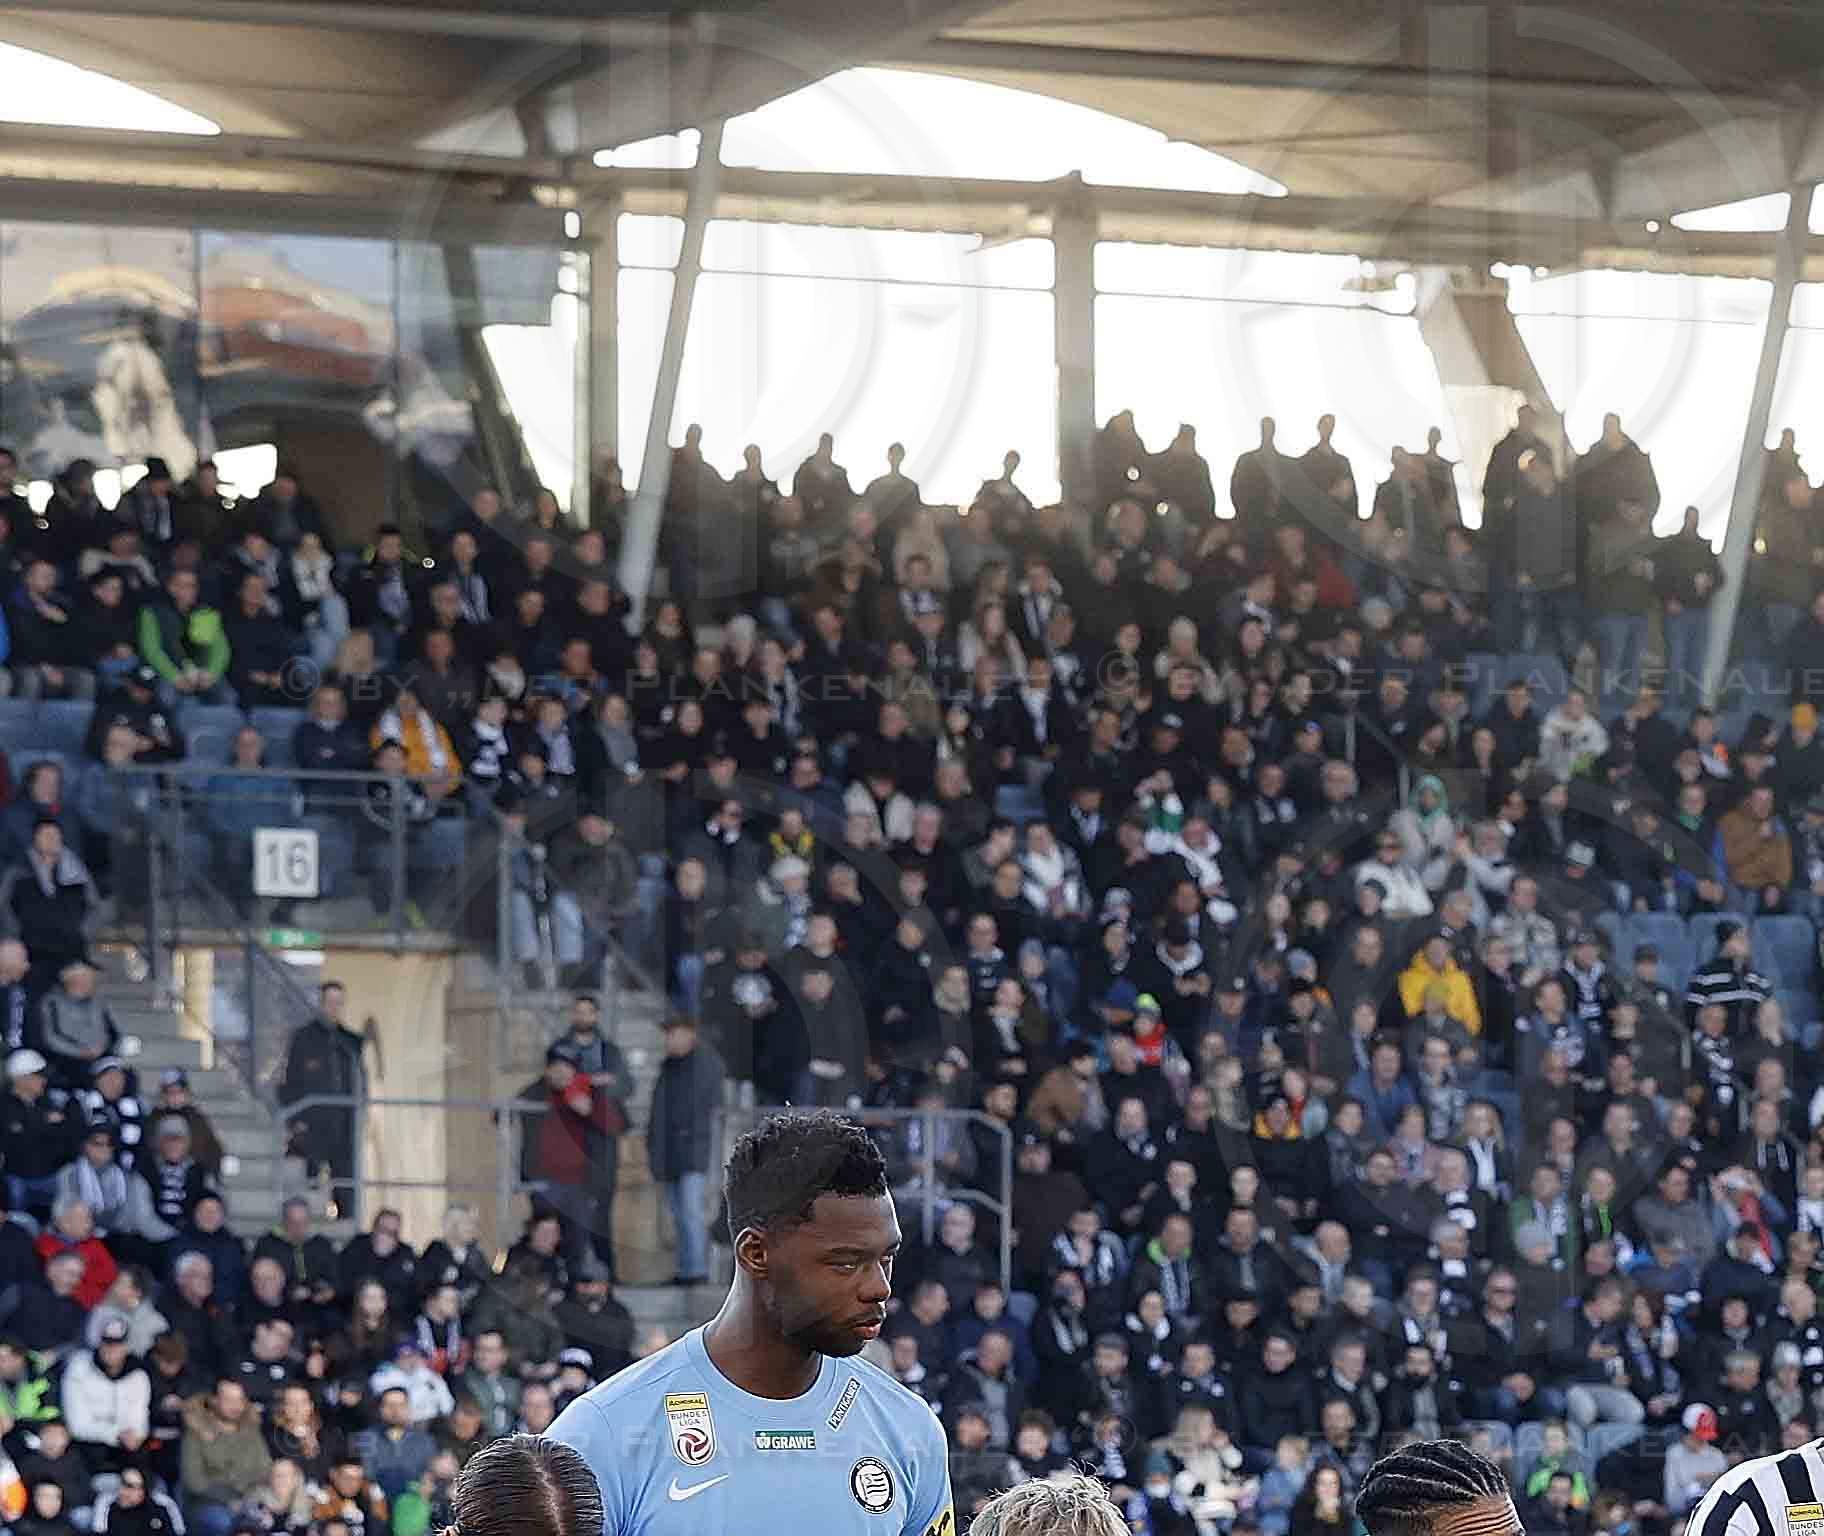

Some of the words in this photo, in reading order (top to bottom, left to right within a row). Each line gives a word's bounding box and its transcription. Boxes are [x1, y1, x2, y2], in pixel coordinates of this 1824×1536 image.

[266, 842, 312, 886] 16
[771, 1436, 816, 1449] GRAWE
[1790, 1521, 1824, 1531] BUNDES
